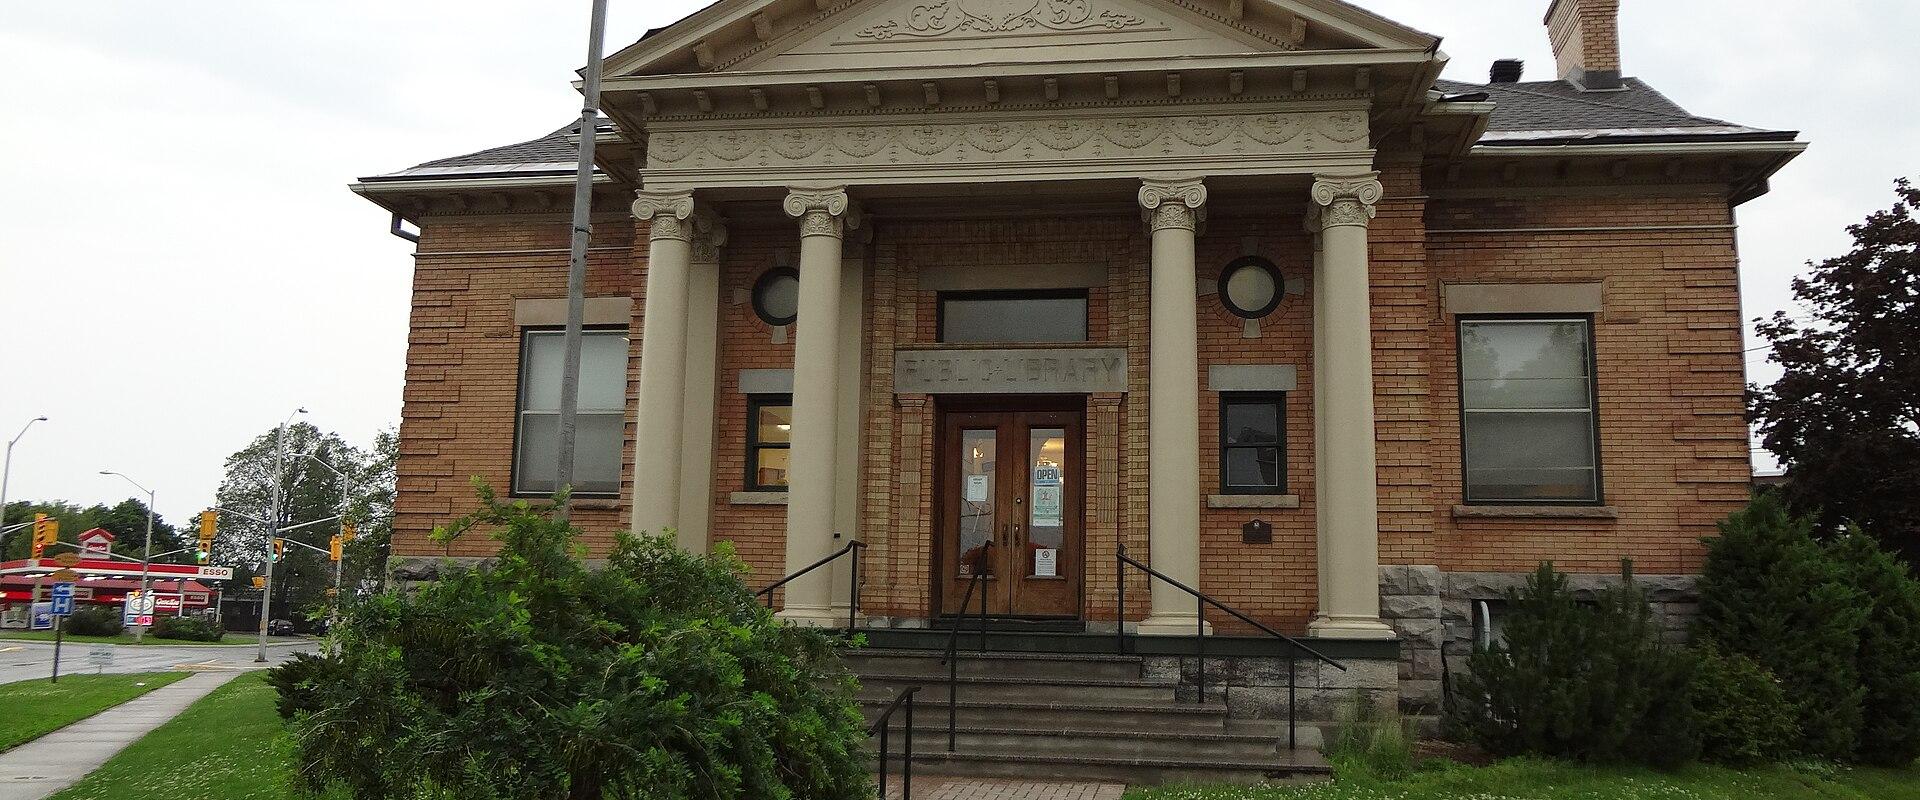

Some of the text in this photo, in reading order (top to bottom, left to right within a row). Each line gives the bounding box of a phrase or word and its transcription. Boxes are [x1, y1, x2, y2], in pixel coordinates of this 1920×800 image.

[903, 357, 1121, 382] PUBLIC LIBRARY
[1037, 468, 1057, 479] OPEN
[203, 568, 228, 576] ESSO
[55, 598, 70, 613] H
